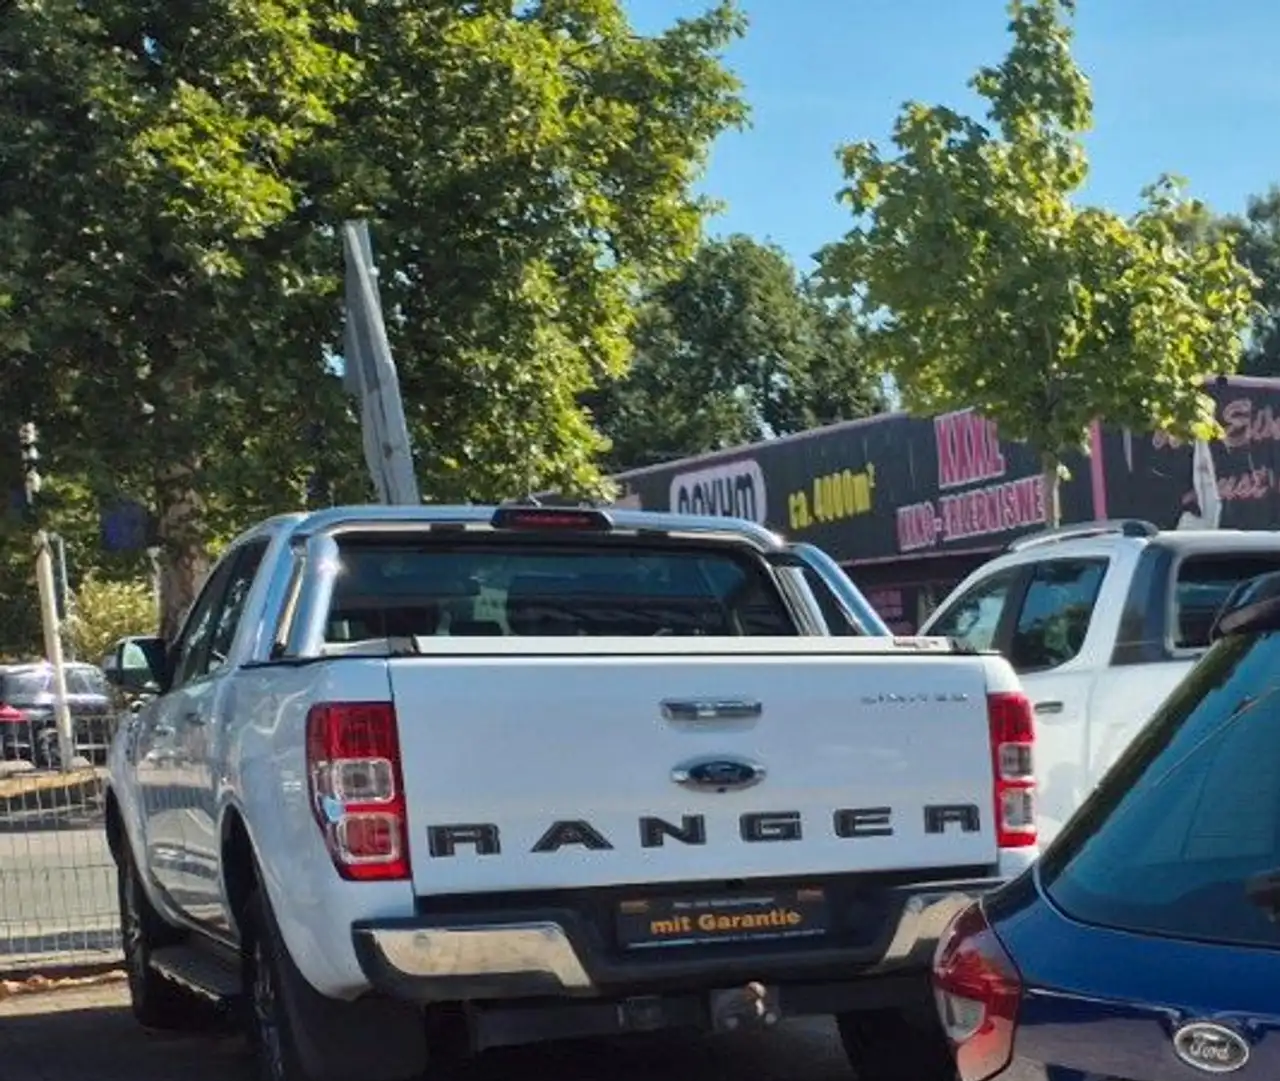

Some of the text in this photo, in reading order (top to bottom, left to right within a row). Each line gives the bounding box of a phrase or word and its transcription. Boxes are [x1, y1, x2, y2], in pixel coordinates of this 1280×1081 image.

[427, 803, 981, 858] RANGER
[651, 909, 801, 934] mit Garantie
[1189, 1031, 1230, 1061] Ford
